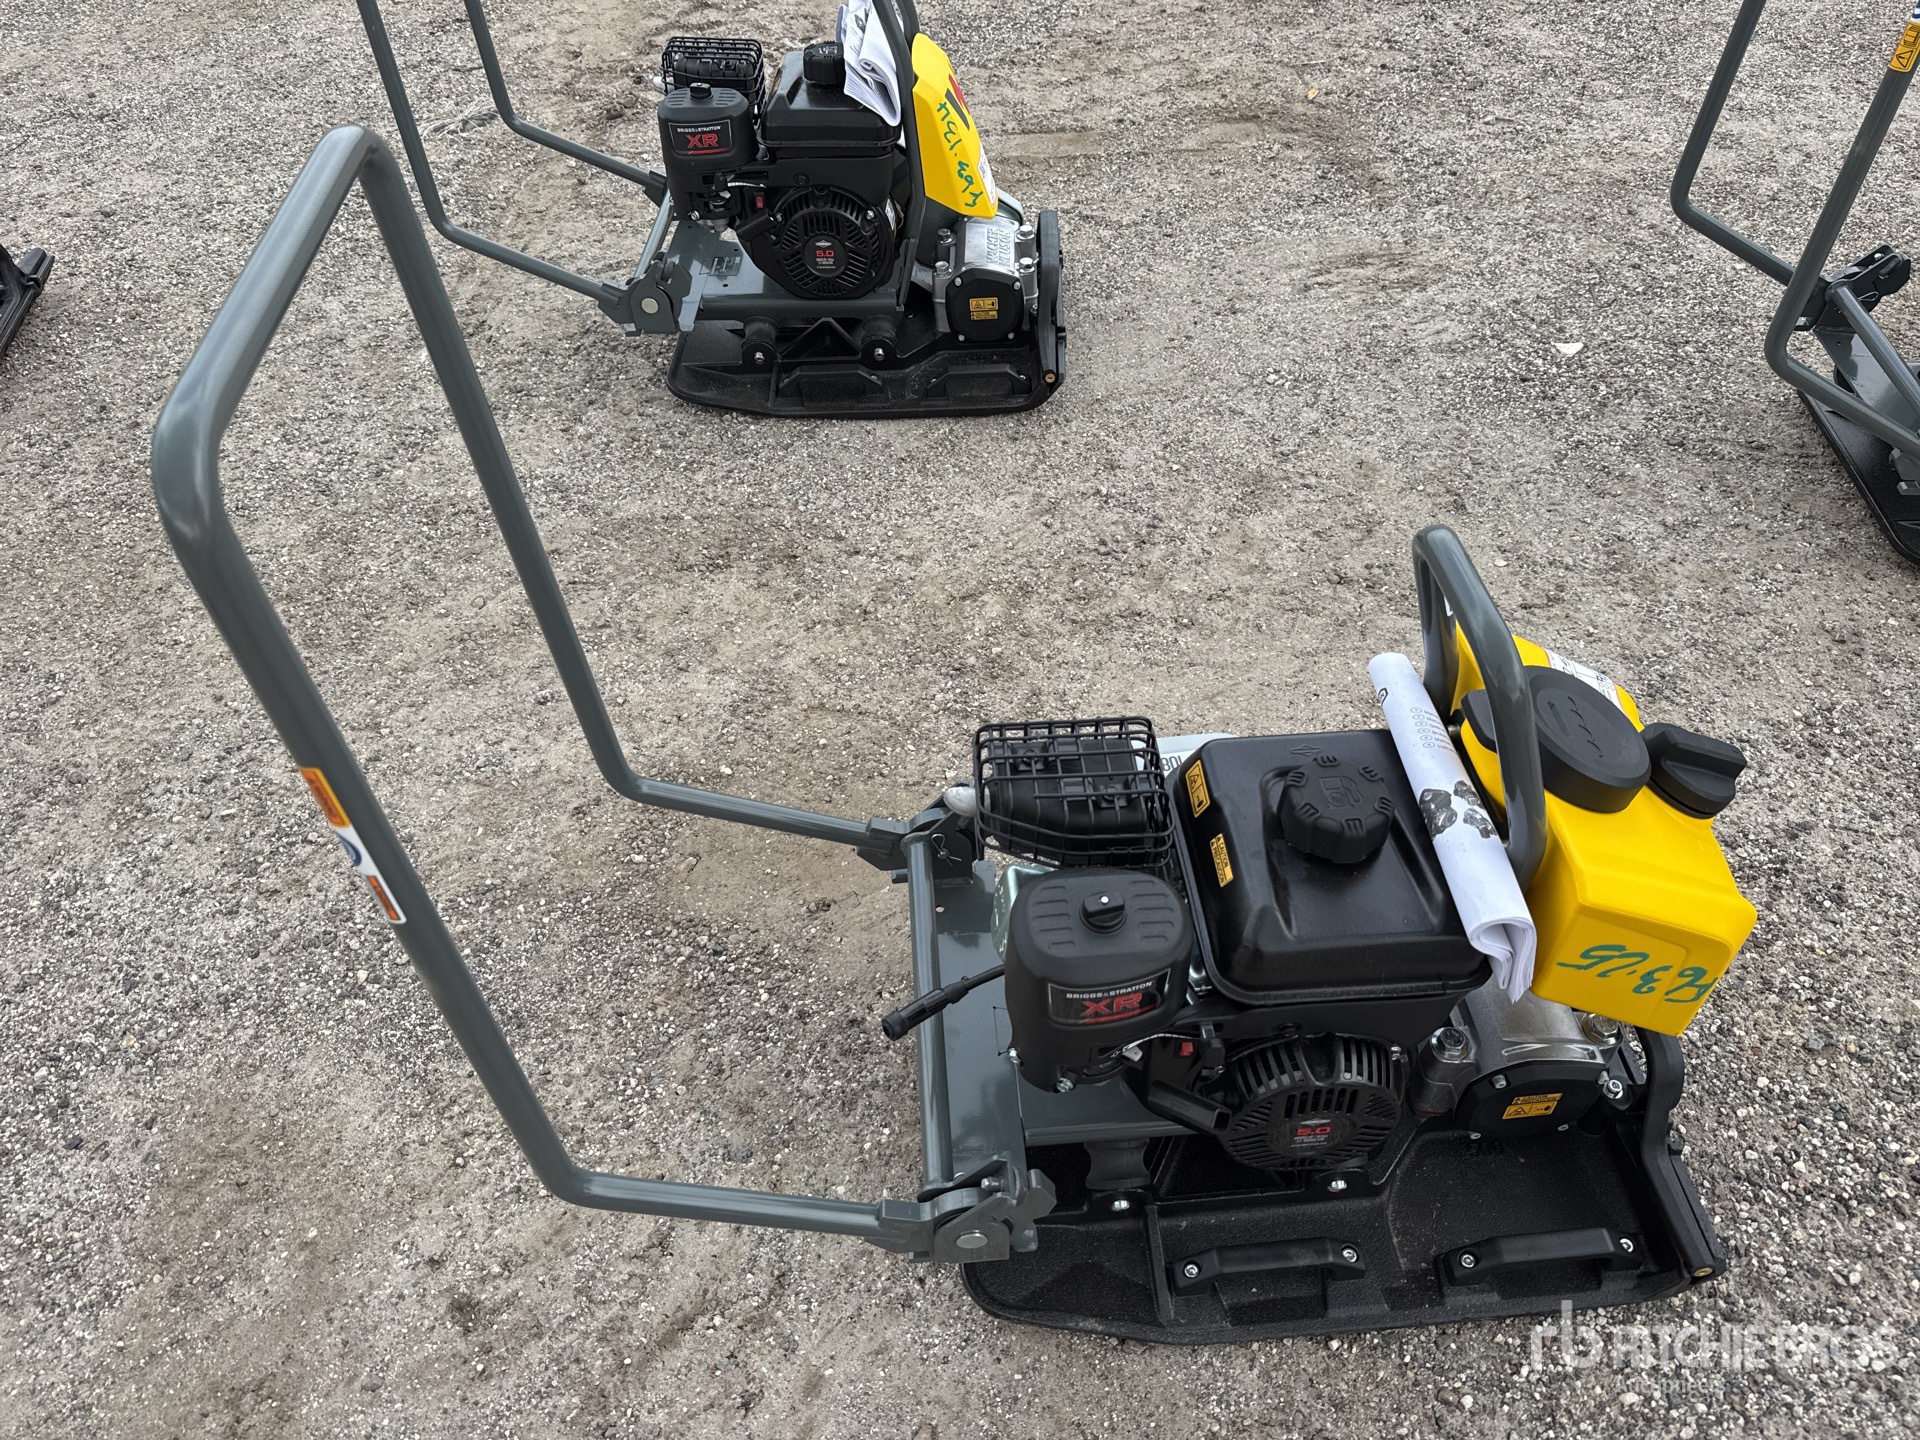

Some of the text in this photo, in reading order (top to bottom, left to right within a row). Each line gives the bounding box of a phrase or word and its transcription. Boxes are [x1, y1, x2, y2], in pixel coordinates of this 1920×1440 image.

[685, 133, 719, 148] XR
[1218, 841, 1229, 868] CAUTION
[1080, 992, 1143, 1017] XR
[1296, 1126, 1332, 1136] 5.0
